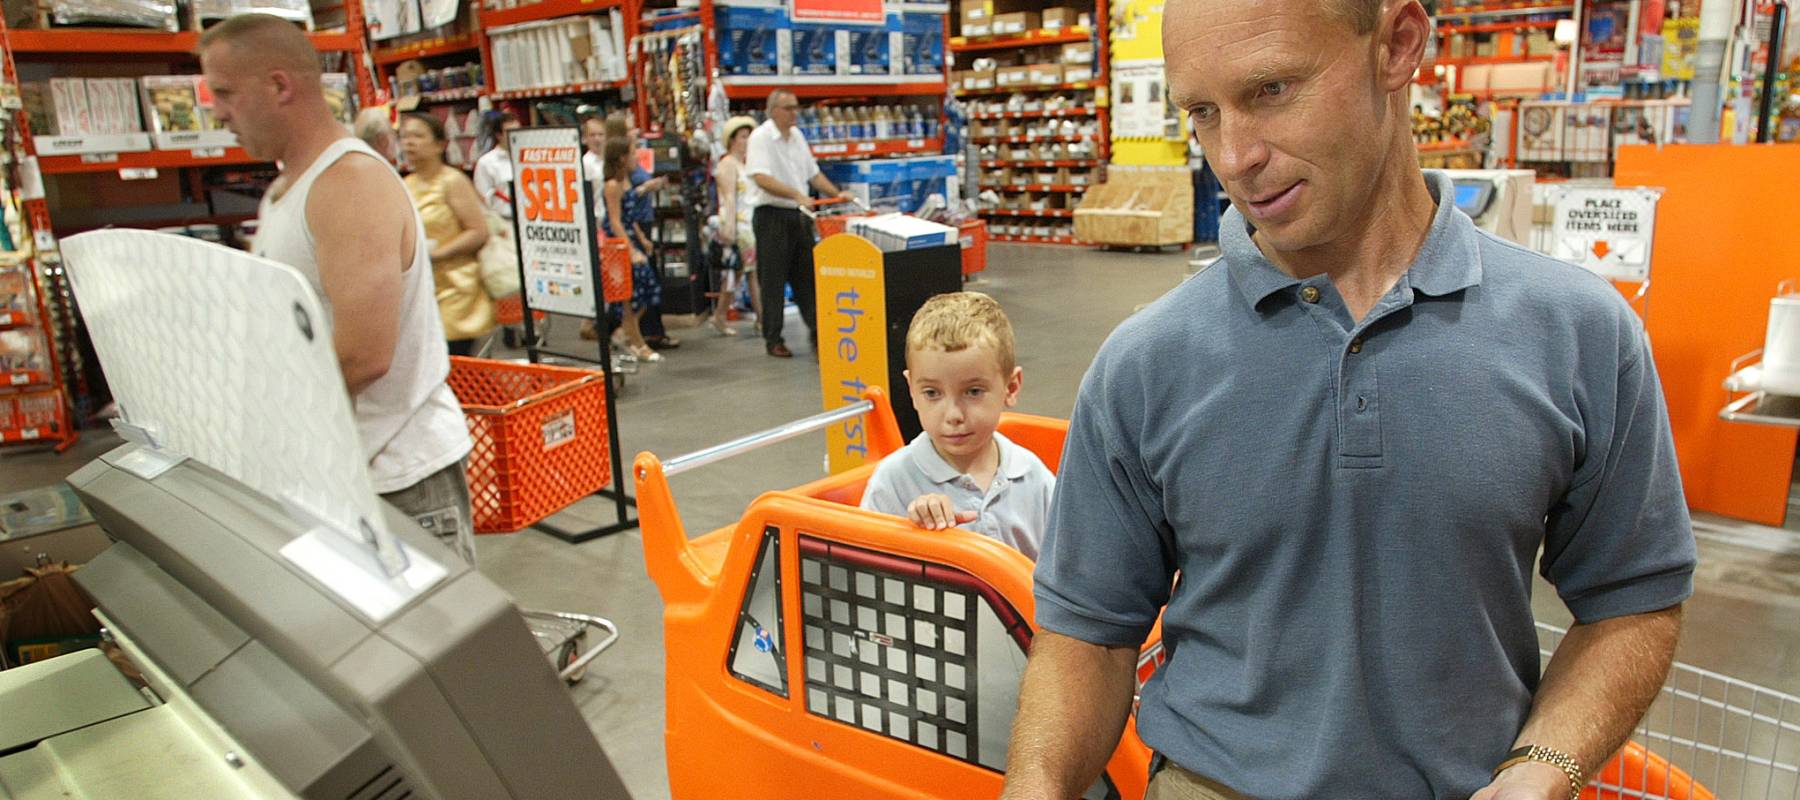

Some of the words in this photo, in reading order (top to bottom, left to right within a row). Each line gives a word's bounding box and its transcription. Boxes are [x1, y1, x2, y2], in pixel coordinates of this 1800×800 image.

[523, 148, 547, 162] FAST
[547, 148, 576, 162] LANE
[521, 168, 577, 223] SELF
[1585, 199, 1621, 208] PLACE
[1568, 210, 1638, 220] OVERSIZED
[526, 225, 581, 244] CHECKOUT
[1566, 221, 1601, 231] ITEMS
[1607, 223, 1638, 232] HERE
[836, 287, 864, 361] the
[840, 377, 868, 458] fist
